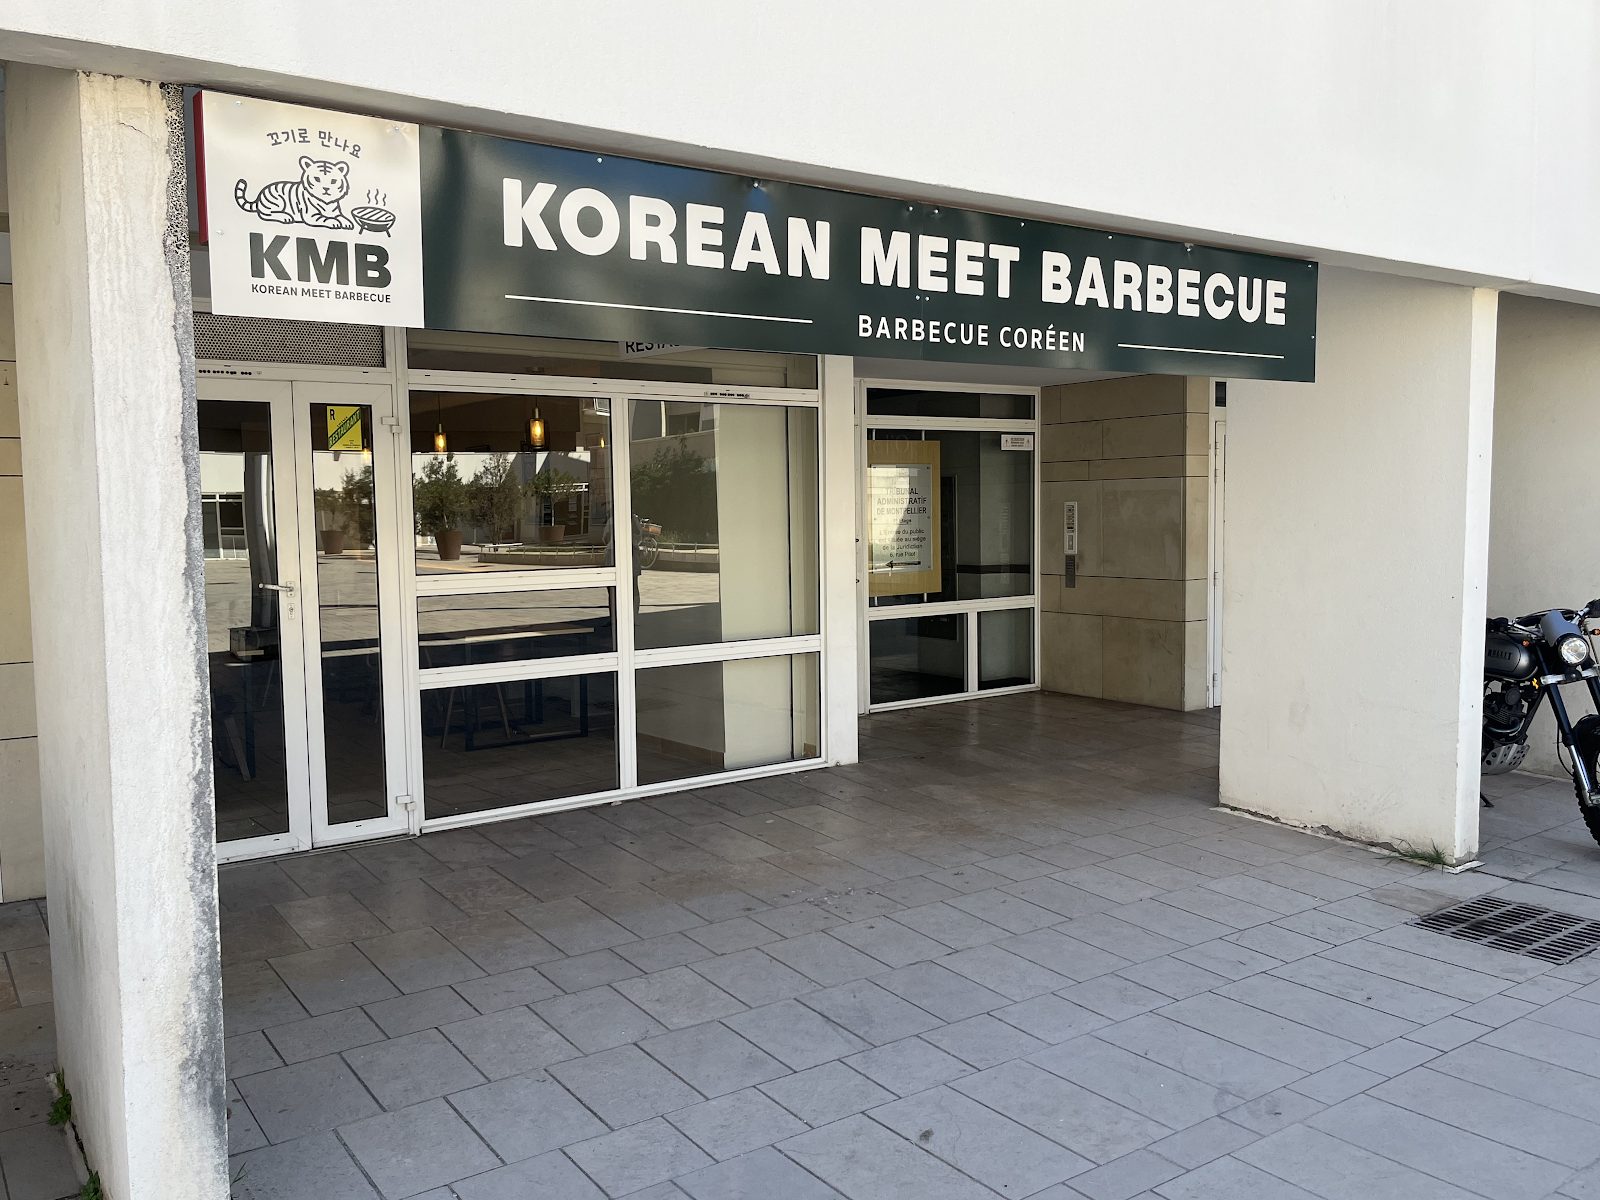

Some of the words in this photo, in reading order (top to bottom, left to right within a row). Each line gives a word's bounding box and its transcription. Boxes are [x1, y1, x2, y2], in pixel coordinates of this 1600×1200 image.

[266, 128, 311, 147] 꼬기로
[318, 130, 362, 159] 만나요
[249, 232, 392, 288] KMB
[502, 177, 831, 281] KOREAN
[860, 226, 1020, 299] MEET
[1041, 250, 1288, 326] BARBECUE
[251, 283, 298, 297] KOREAN
[301, 288, 332, 299] MEET
[334, 290, 392, 304] BARBECUE
[858, 313, 989, 346] BARBECUE
[998, 323, 1086, 353] CORÉEN
[328, 411, 361, 446] RESTAURANT
[330, 409, 335, 420] R
[877, 496, 927, 504] ADMINISTRATIF
